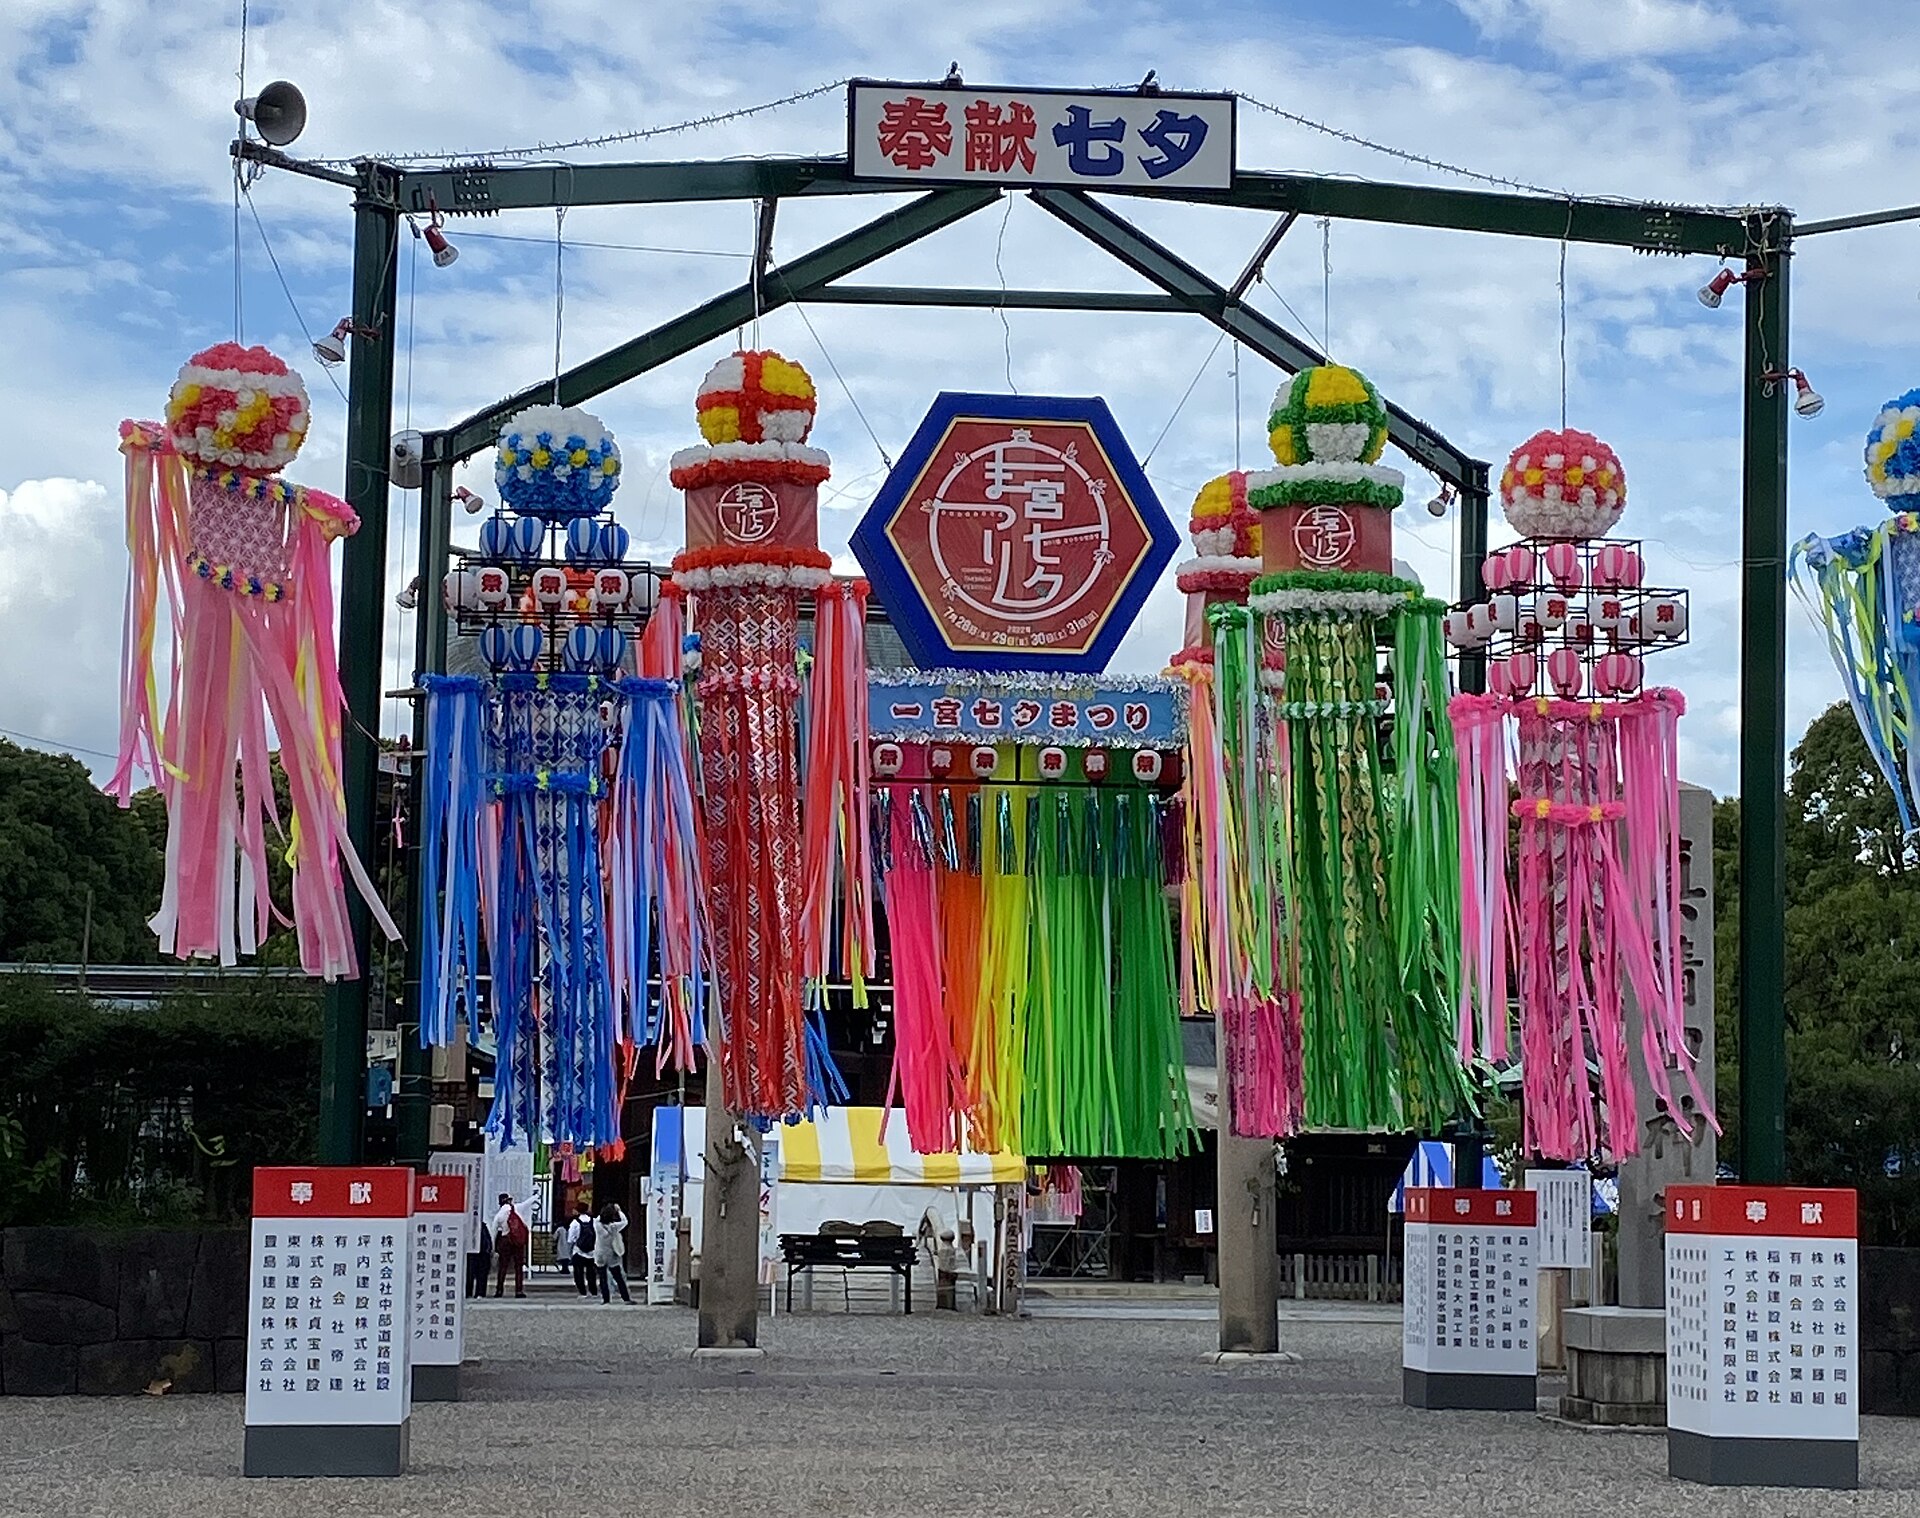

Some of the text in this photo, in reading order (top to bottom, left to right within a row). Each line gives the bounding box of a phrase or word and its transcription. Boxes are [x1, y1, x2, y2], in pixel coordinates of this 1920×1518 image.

[877, 96, 1209, 179] 奉献七夕
[889, 697, 1152, 732] 一宮七夕まつり
[291, 1182, 372, 1204] 奉献
[1746, 1201, 1823, 1224] 奉献
[283, 1235, 301, 1392] 東海建設株式会社
[352, 1235, 371, 1392] 坪内建設株式会社
